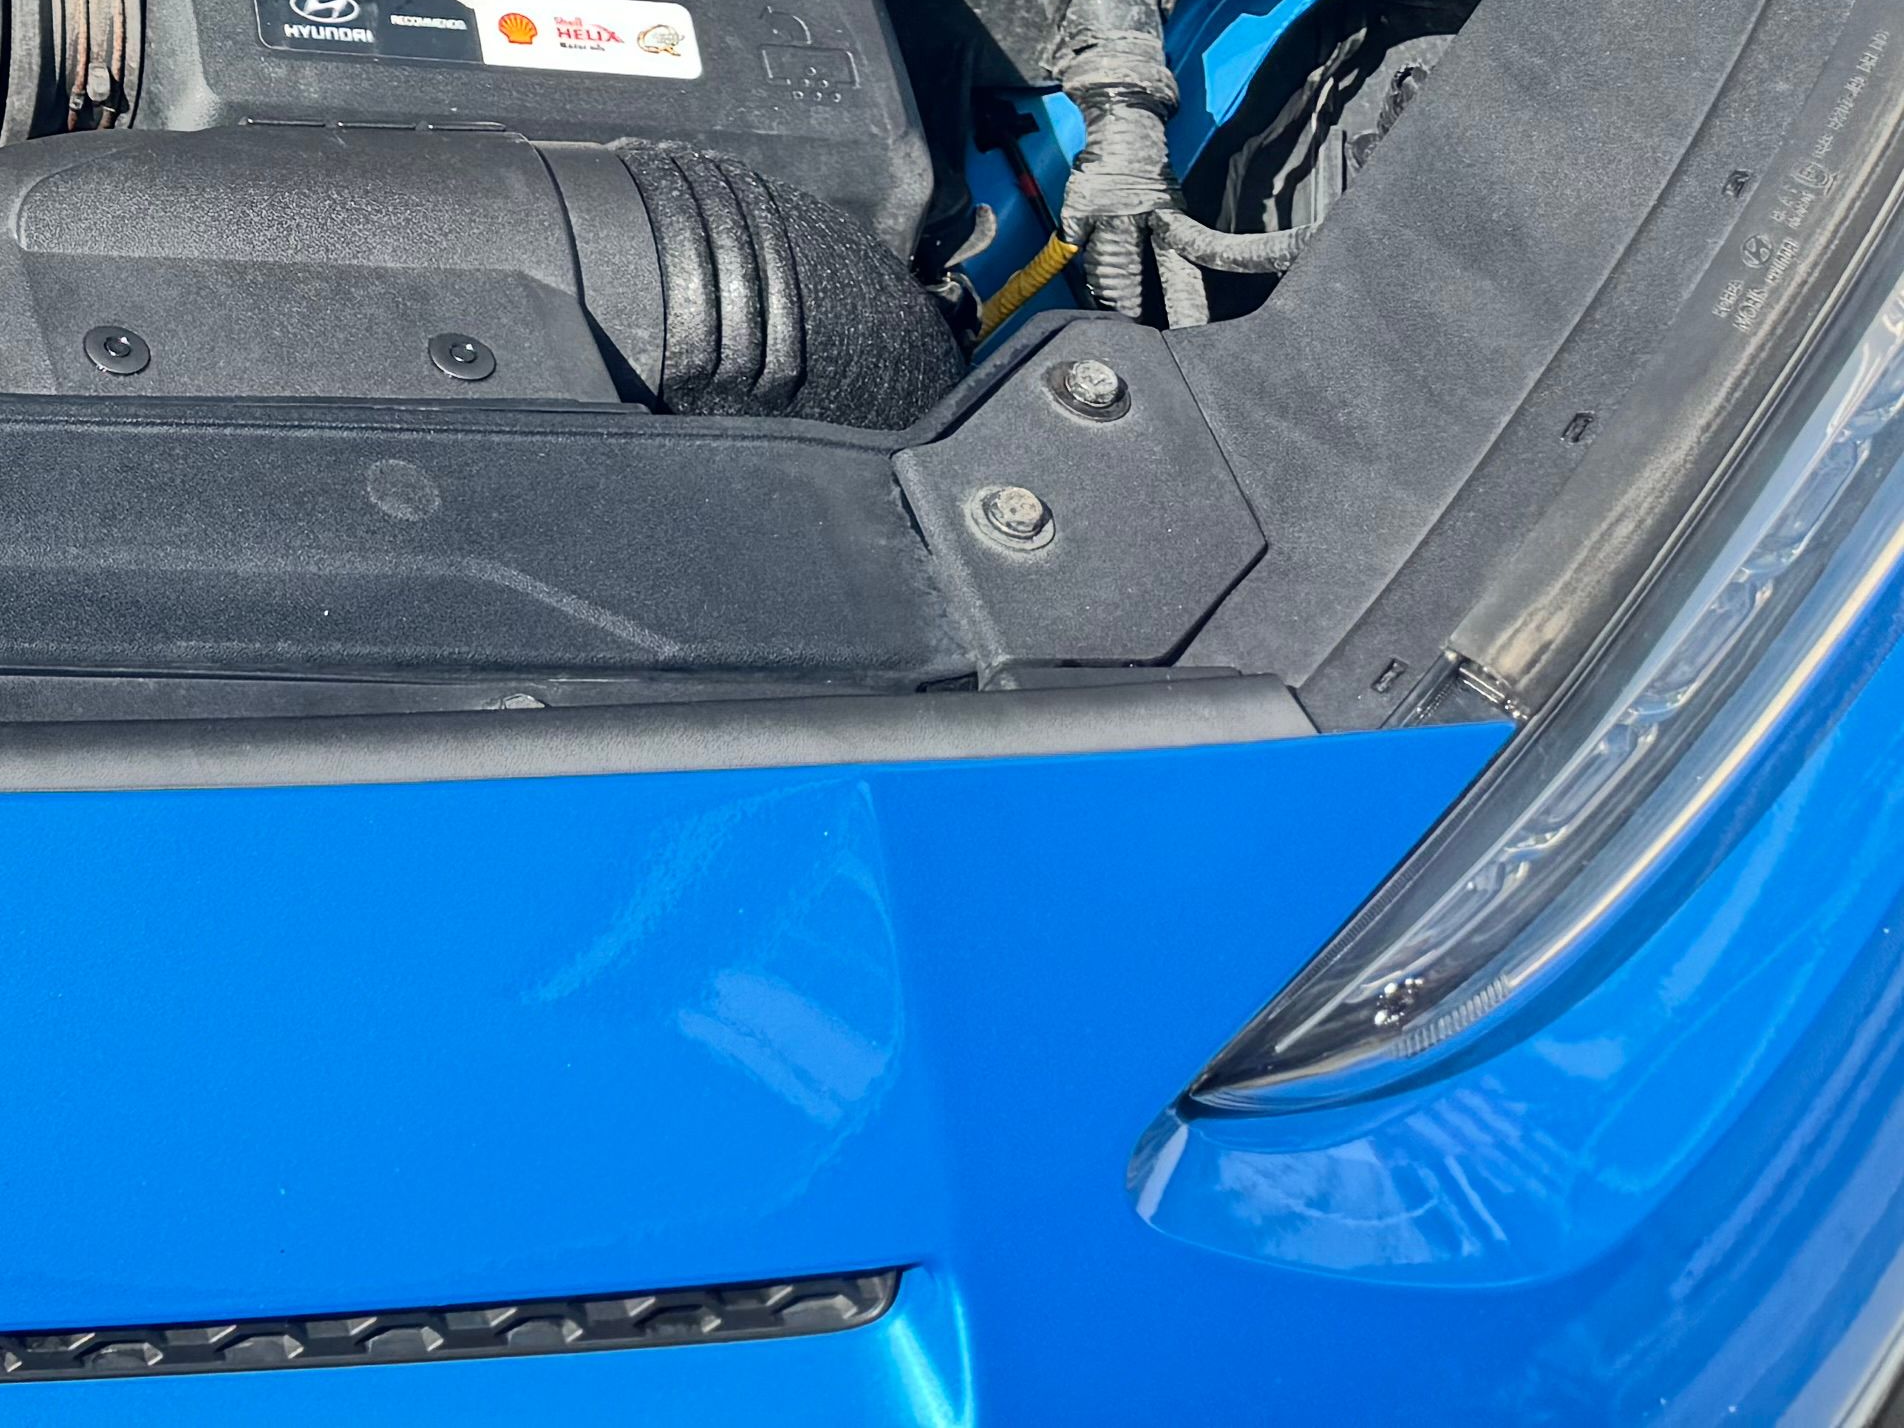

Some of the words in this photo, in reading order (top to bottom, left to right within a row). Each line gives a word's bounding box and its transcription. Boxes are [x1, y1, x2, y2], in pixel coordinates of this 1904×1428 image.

[553, 16, 582, 26] Shell
[283, 24, 375, 43] HYUNDAI
[557, 24, 625, 44] HELIX
